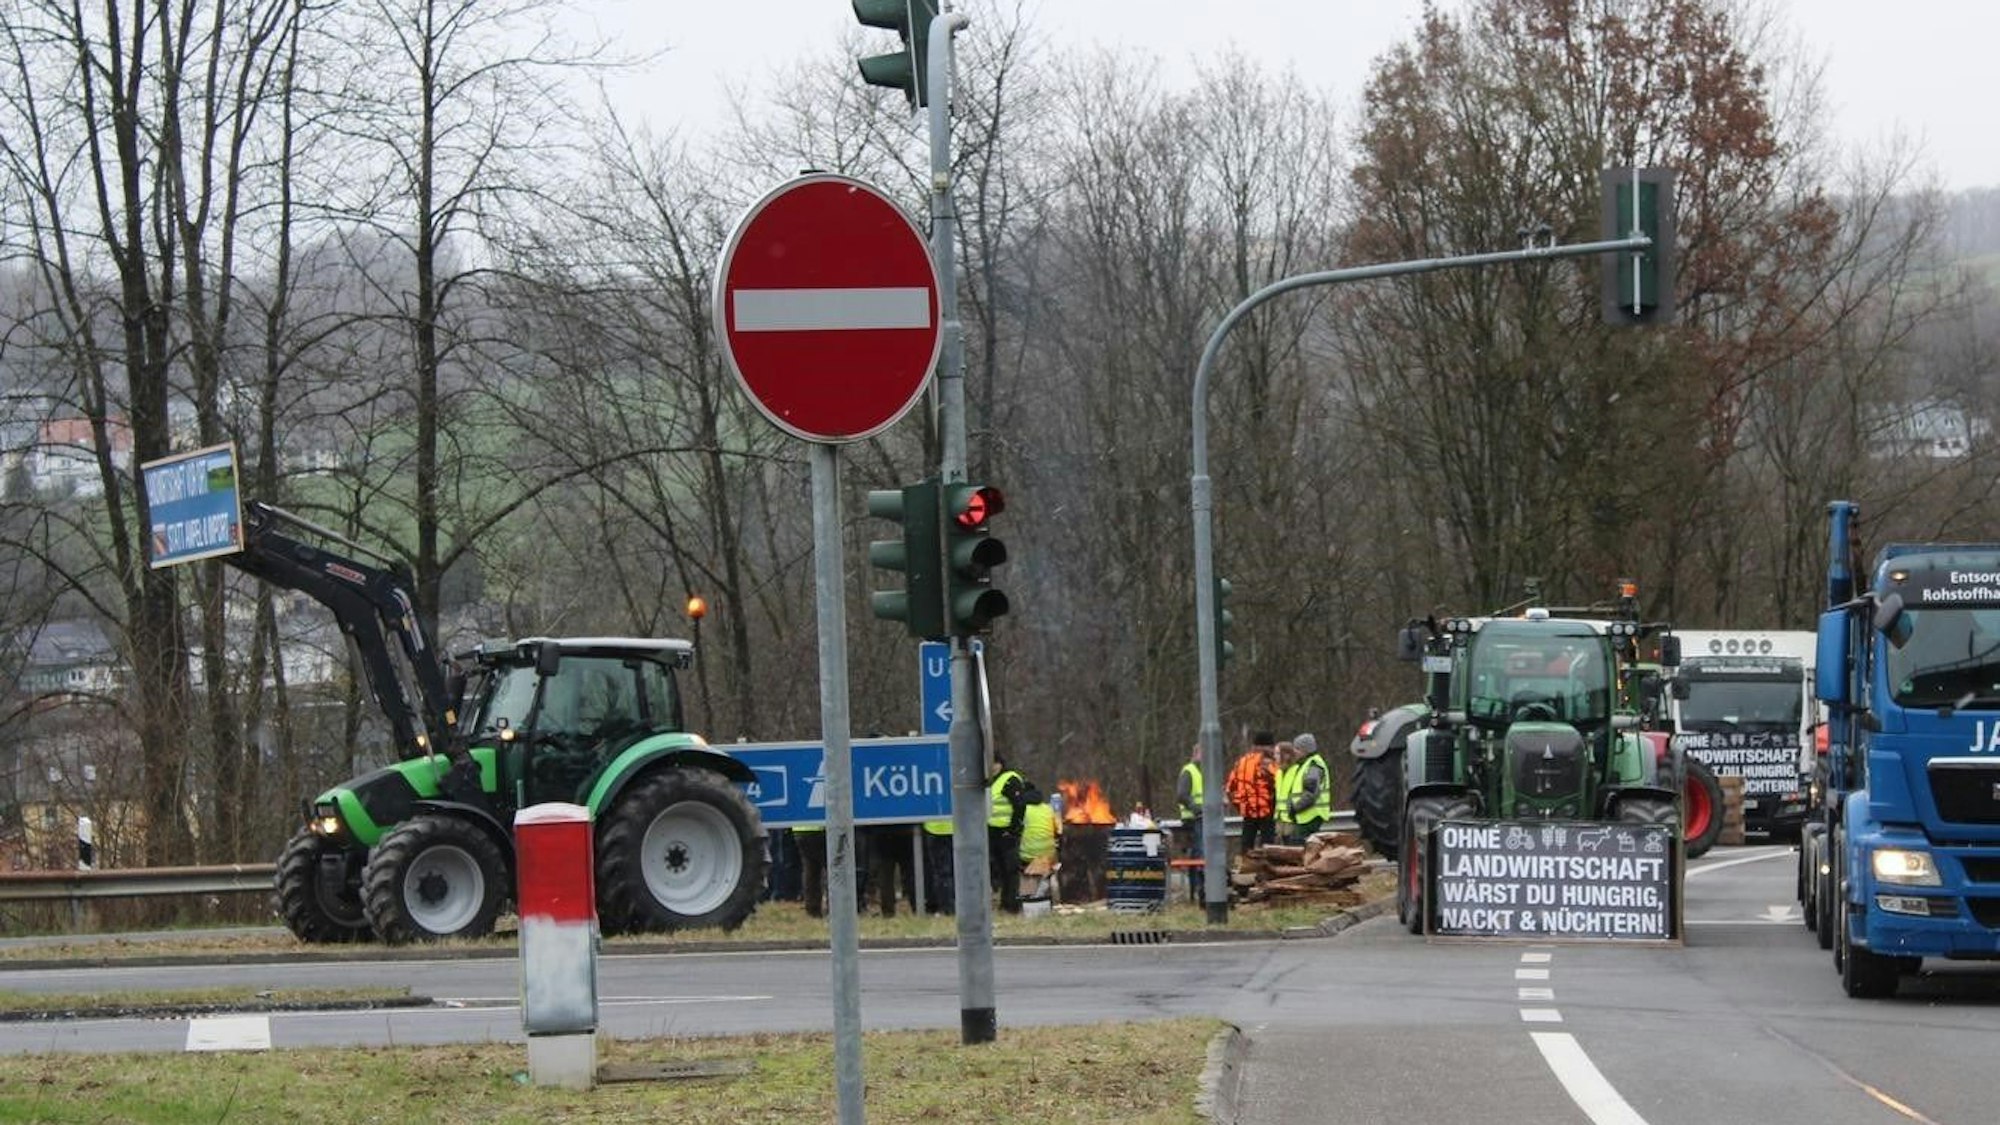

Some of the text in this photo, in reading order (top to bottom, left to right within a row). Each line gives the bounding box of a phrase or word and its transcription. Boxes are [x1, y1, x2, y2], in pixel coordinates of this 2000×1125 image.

[928, 657, 951, 678] U
[863, 765, 943, 798] Köln
[1443, 827, 1500, 849] OHNE
[1442, 854, 1664, 881] LANDWIRTSCHAFT
[1443, 879, 1663, 911] WÄRST DU HUNGRIG,
[1442, 907, 1664, 934] NACKT & NÜCHTERN!
